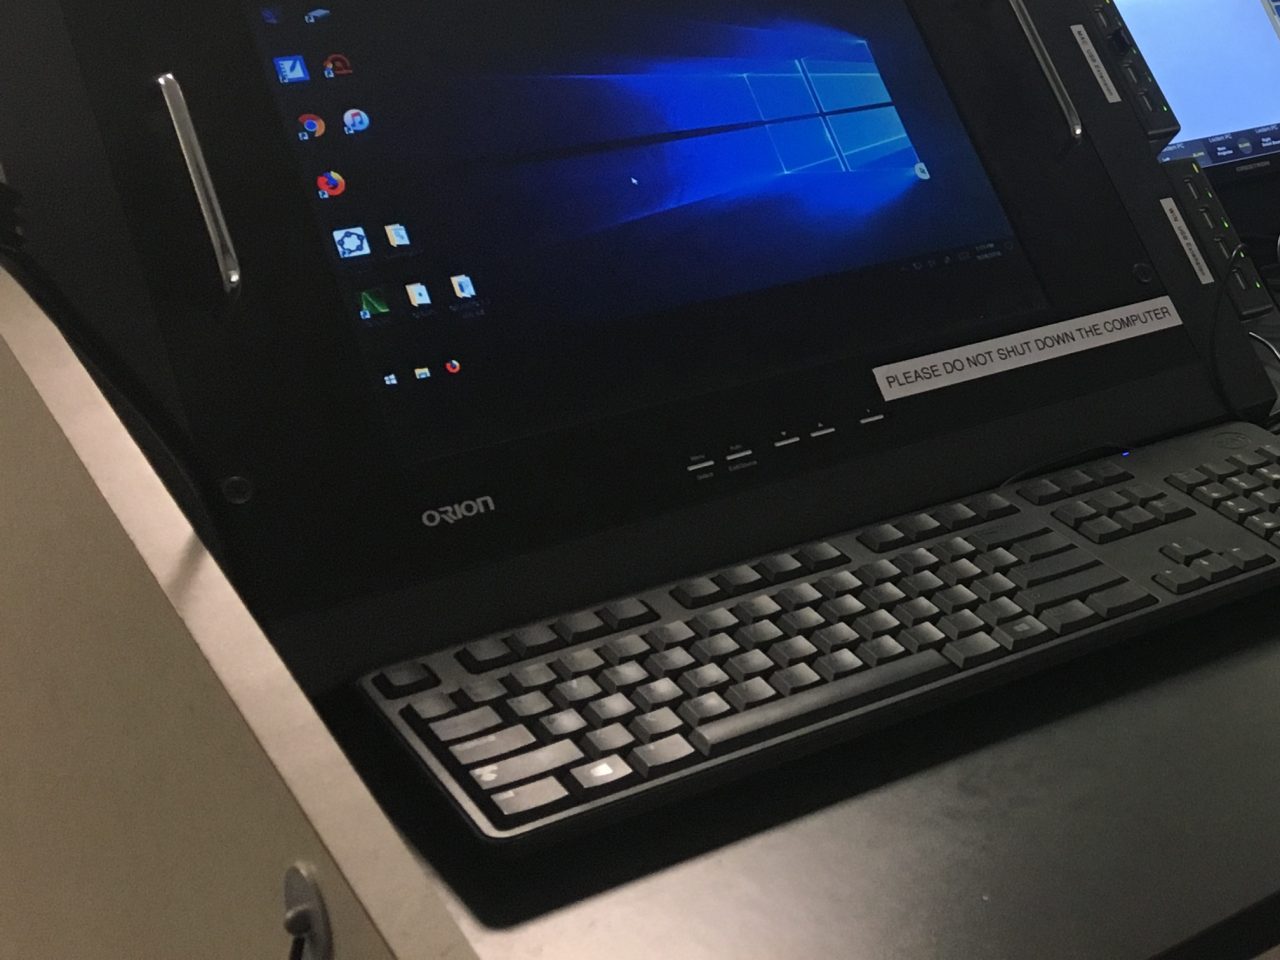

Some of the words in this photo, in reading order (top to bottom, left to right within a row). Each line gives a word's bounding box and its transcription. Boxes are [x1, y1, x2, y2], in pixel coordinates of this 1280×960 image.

[885, 364, 942, 389] PLEASE
[942, 358, 965, 375] DO
[965, 350, 996, 370] NOT
[996, 340, 1035, 361] SHUT
[1034, 330, 1076, 352] DOWN
[1075, 323, 1104, 341] THE
[1103, 305, 1173, 333] COMPUTER
[421, 495, 496, 527] ORION
